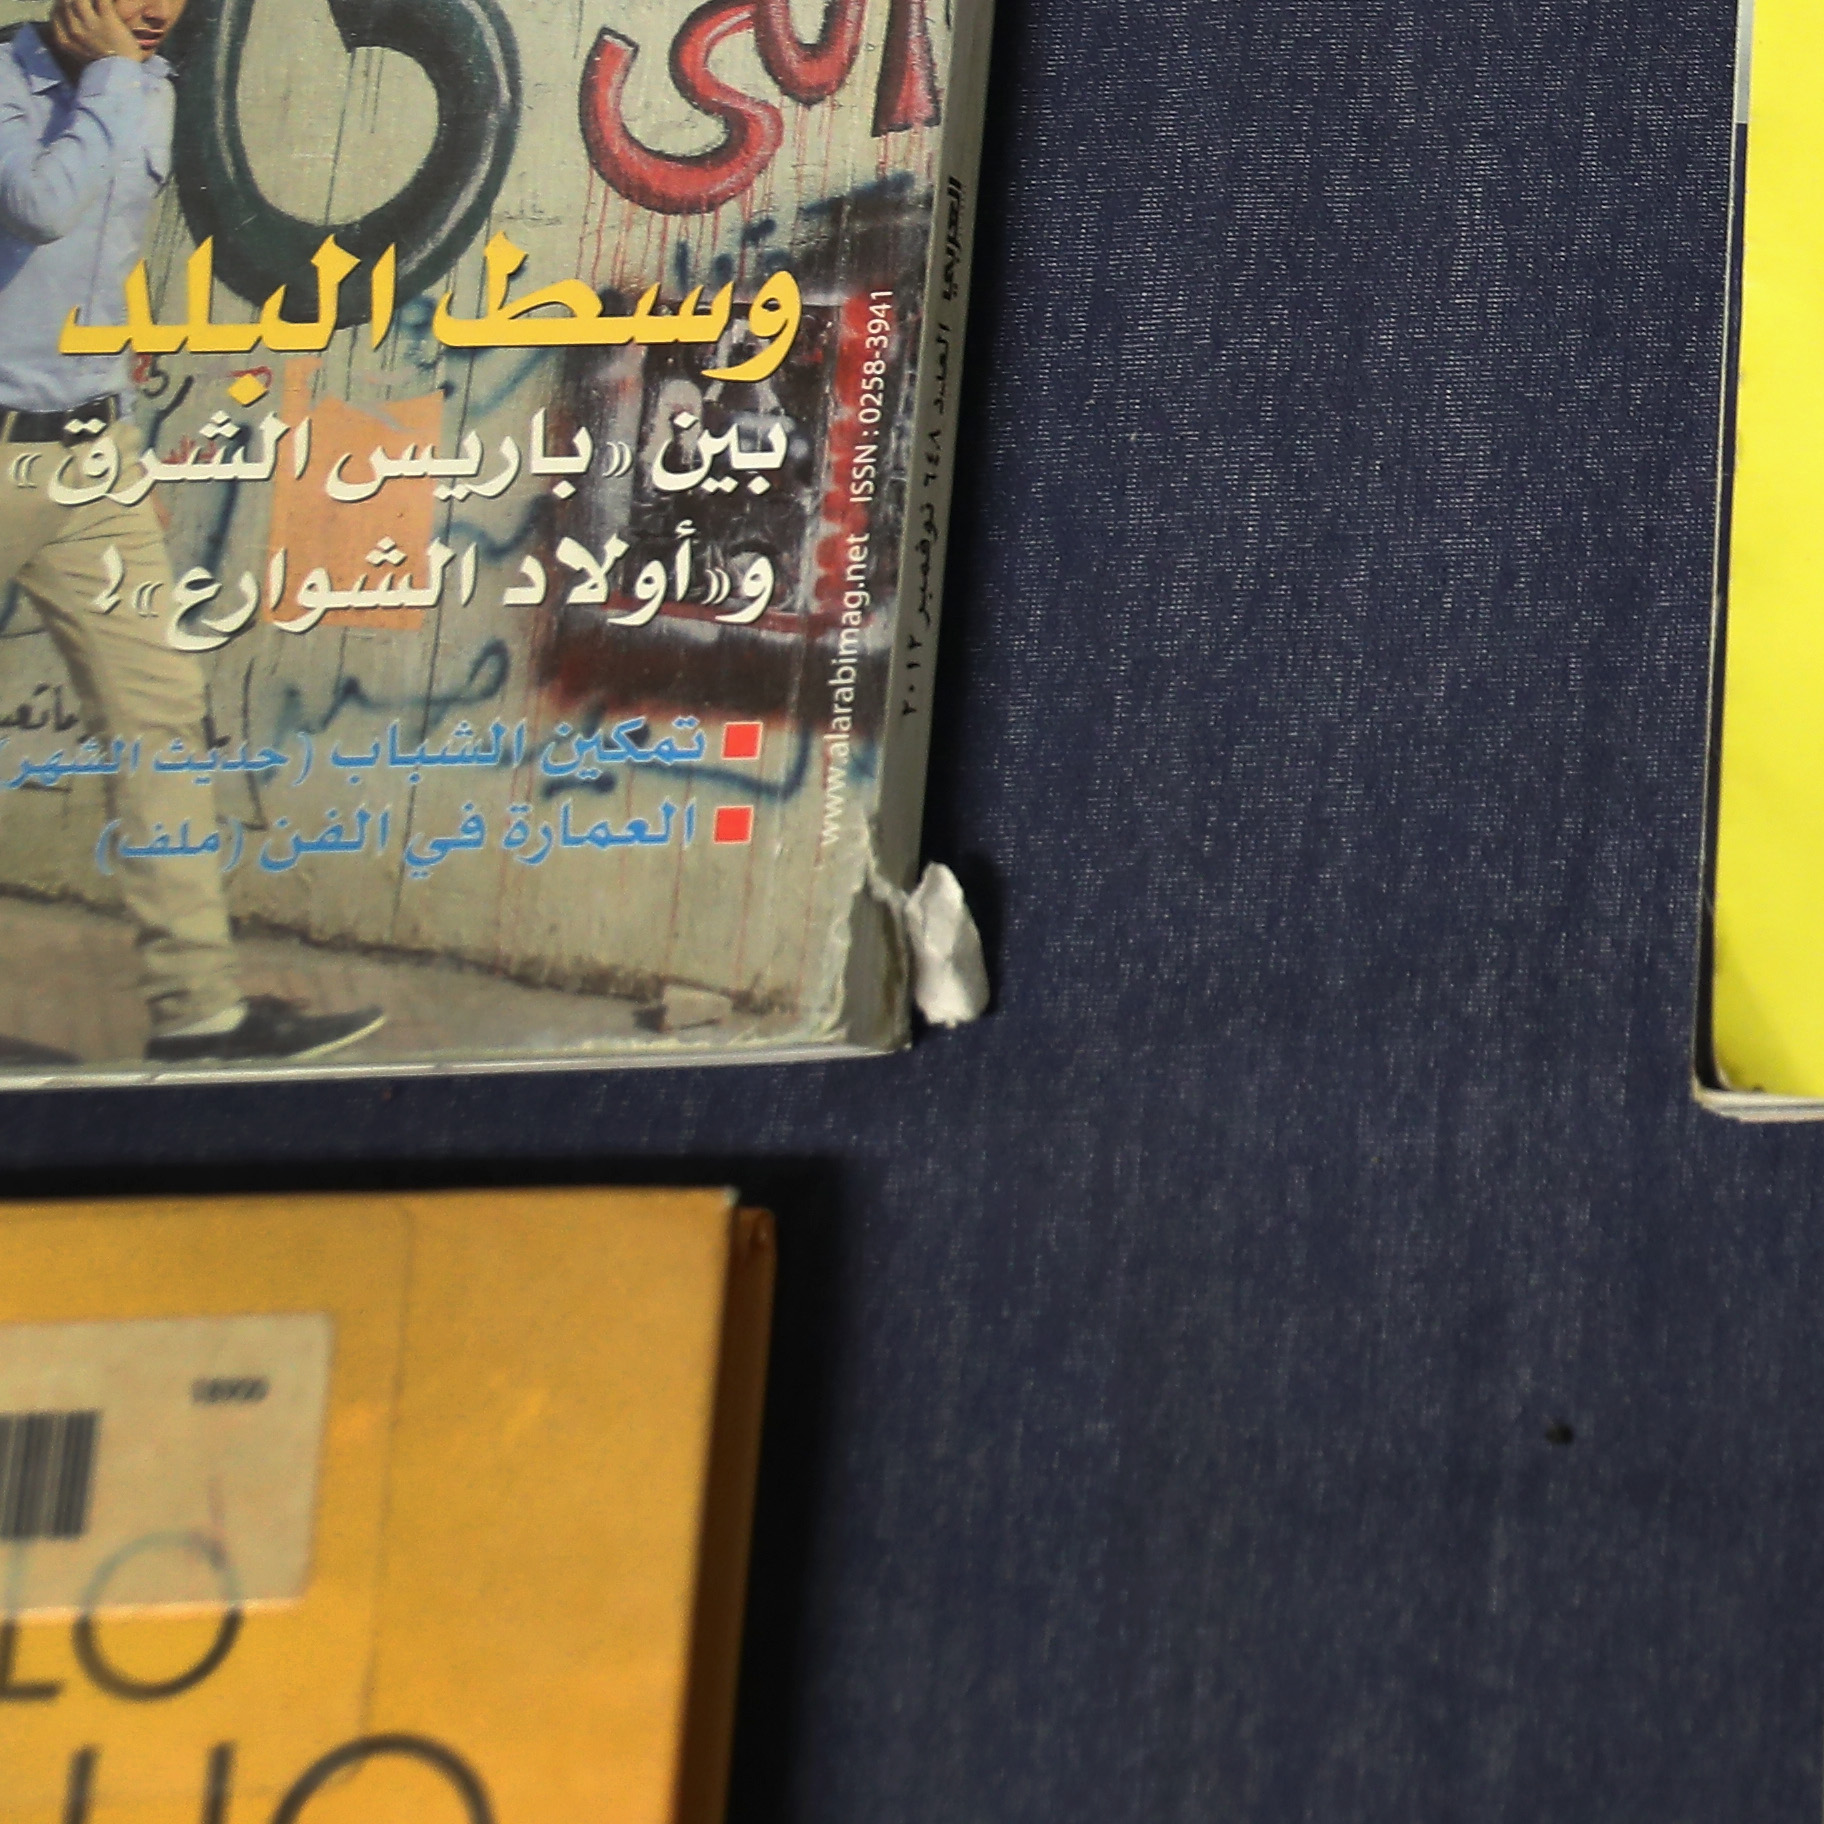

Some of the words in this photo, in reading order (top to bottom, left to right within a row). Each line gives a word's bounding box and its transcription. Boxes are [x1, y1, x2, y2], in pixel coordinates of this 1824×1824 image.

[940, 174, 966, 304] العربي
[58, 232, 397, 406] البلد
[433, 230, 803, 381] وسط
[857, 288, 894, 423] 0258-3941
[934, 325, 953, 416] العدد
[652, 410, 788, 496] بين
[848, 449, 874, 503] ISSN
[912, 505, 938, 623] نوفمبر
[815, 531, 875, 849] www.alarabimag.net
[901, 628, 925, 717] ٢٠١٢
[330, 716, 526, 789] الشباب
[538, 714, 709, 782] تمكين
[257, 802, 392, 874] الفن
[399, 800, 487, 880] في
[501, 798, 696, 867] العمارة
